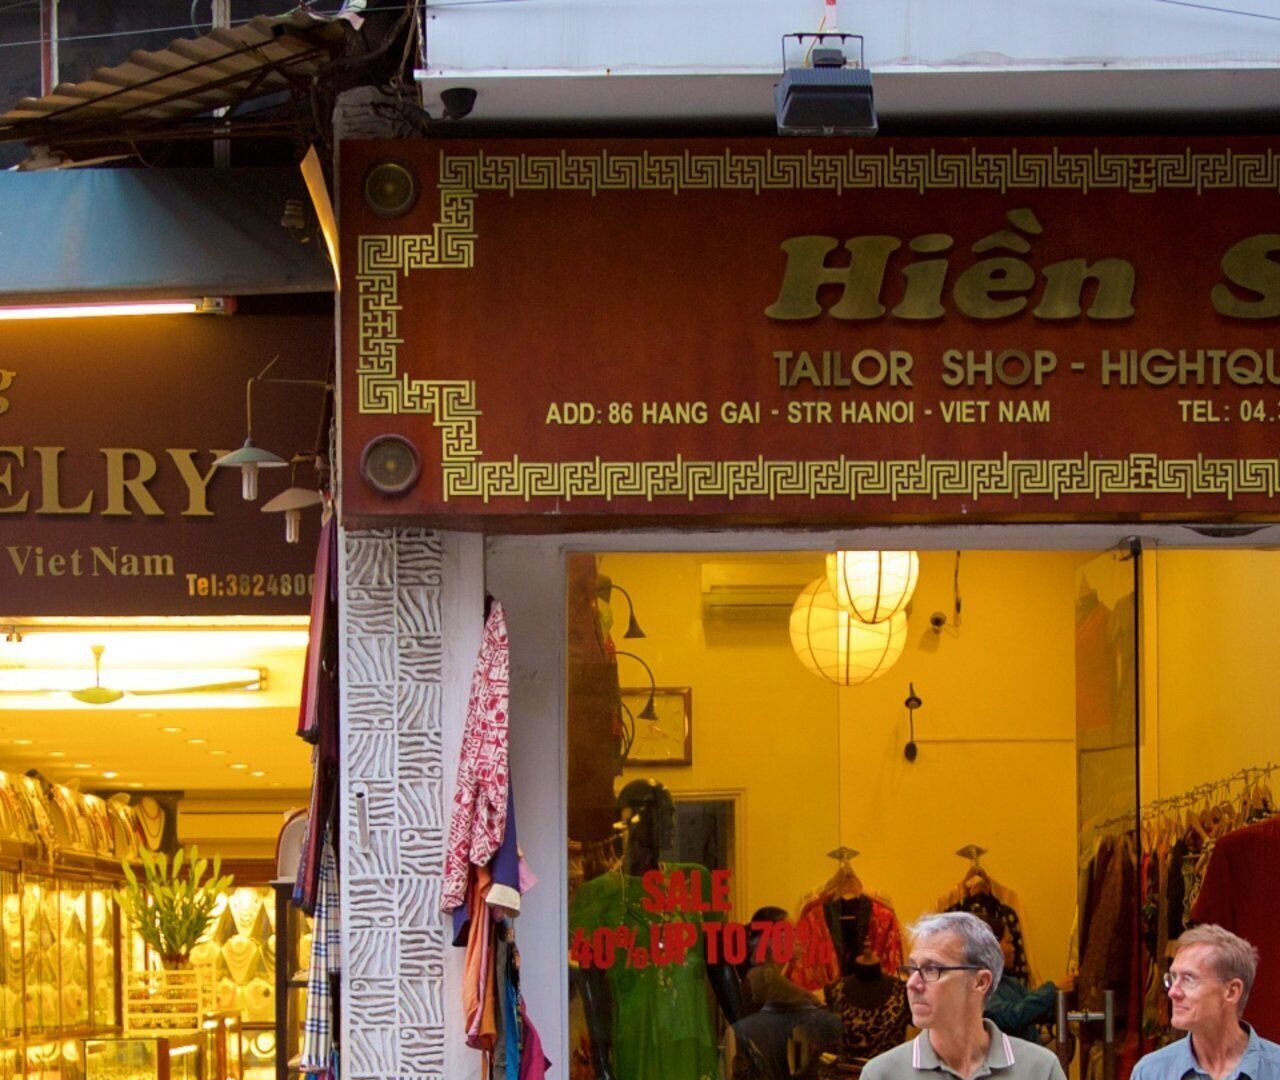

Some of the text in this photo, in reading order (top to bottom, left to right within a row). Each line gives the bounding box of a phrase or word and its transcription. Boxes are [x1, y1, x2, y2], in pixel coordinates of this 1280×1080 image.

[764, 207, 1136, 321] Hiền
[773, 350, 914, 388] TAILOR
[941, 350, 1057, 388] SHOP
[546, 402, 602, 425] ADD:
[609, 402, 633, 425] 86
[642, 402, 708, 425] HANG
[720, 402, 760, 424] GAI
[787, 402, 833, 424] STR
[841, 401, 914, 424] HANOI
[940, 401, 990, 423] VIET
[999, 401, 1051, 423] NAM
[1179, 401, 1231, 423] TEL:
[642, 870, 732, 913] SALE
[702, 922, 747, 964] TO
